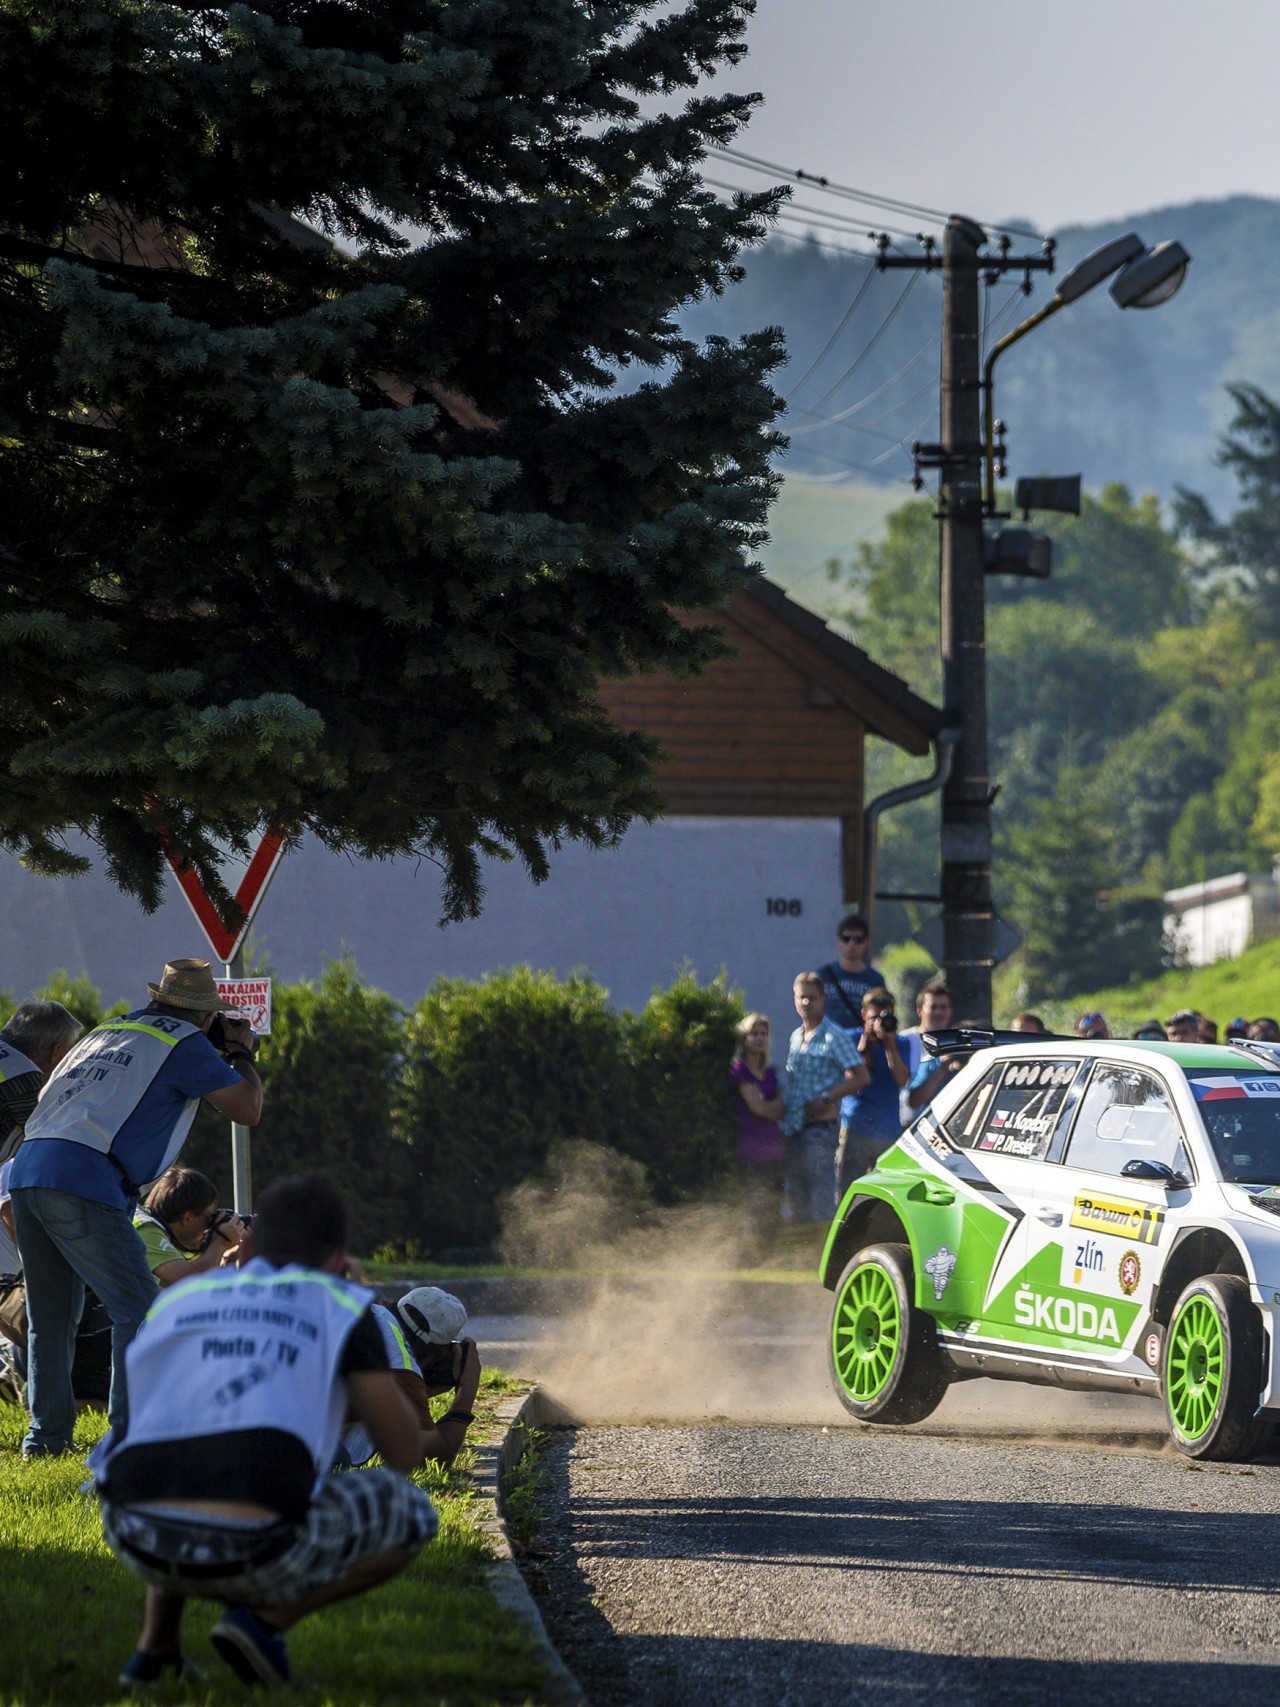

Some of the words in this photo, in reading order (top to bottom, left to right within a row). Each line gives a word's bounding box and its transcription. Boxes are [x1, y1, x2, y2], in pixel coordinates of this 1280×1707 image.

[218, 980, 268, 994] AKÁZANÝ
[222, 994, 266, 1006] ROSTOR
[152, 1017, 181, 1033] 63
[93, 1068, 110, 1081] TV
[962, 1083, 994, 1136] 1
[1014, 1282, 1121, 1343] ŠKODA
[202, 1336, 257, 1361] Photo
[276, 1340, 299, 1368] TV
